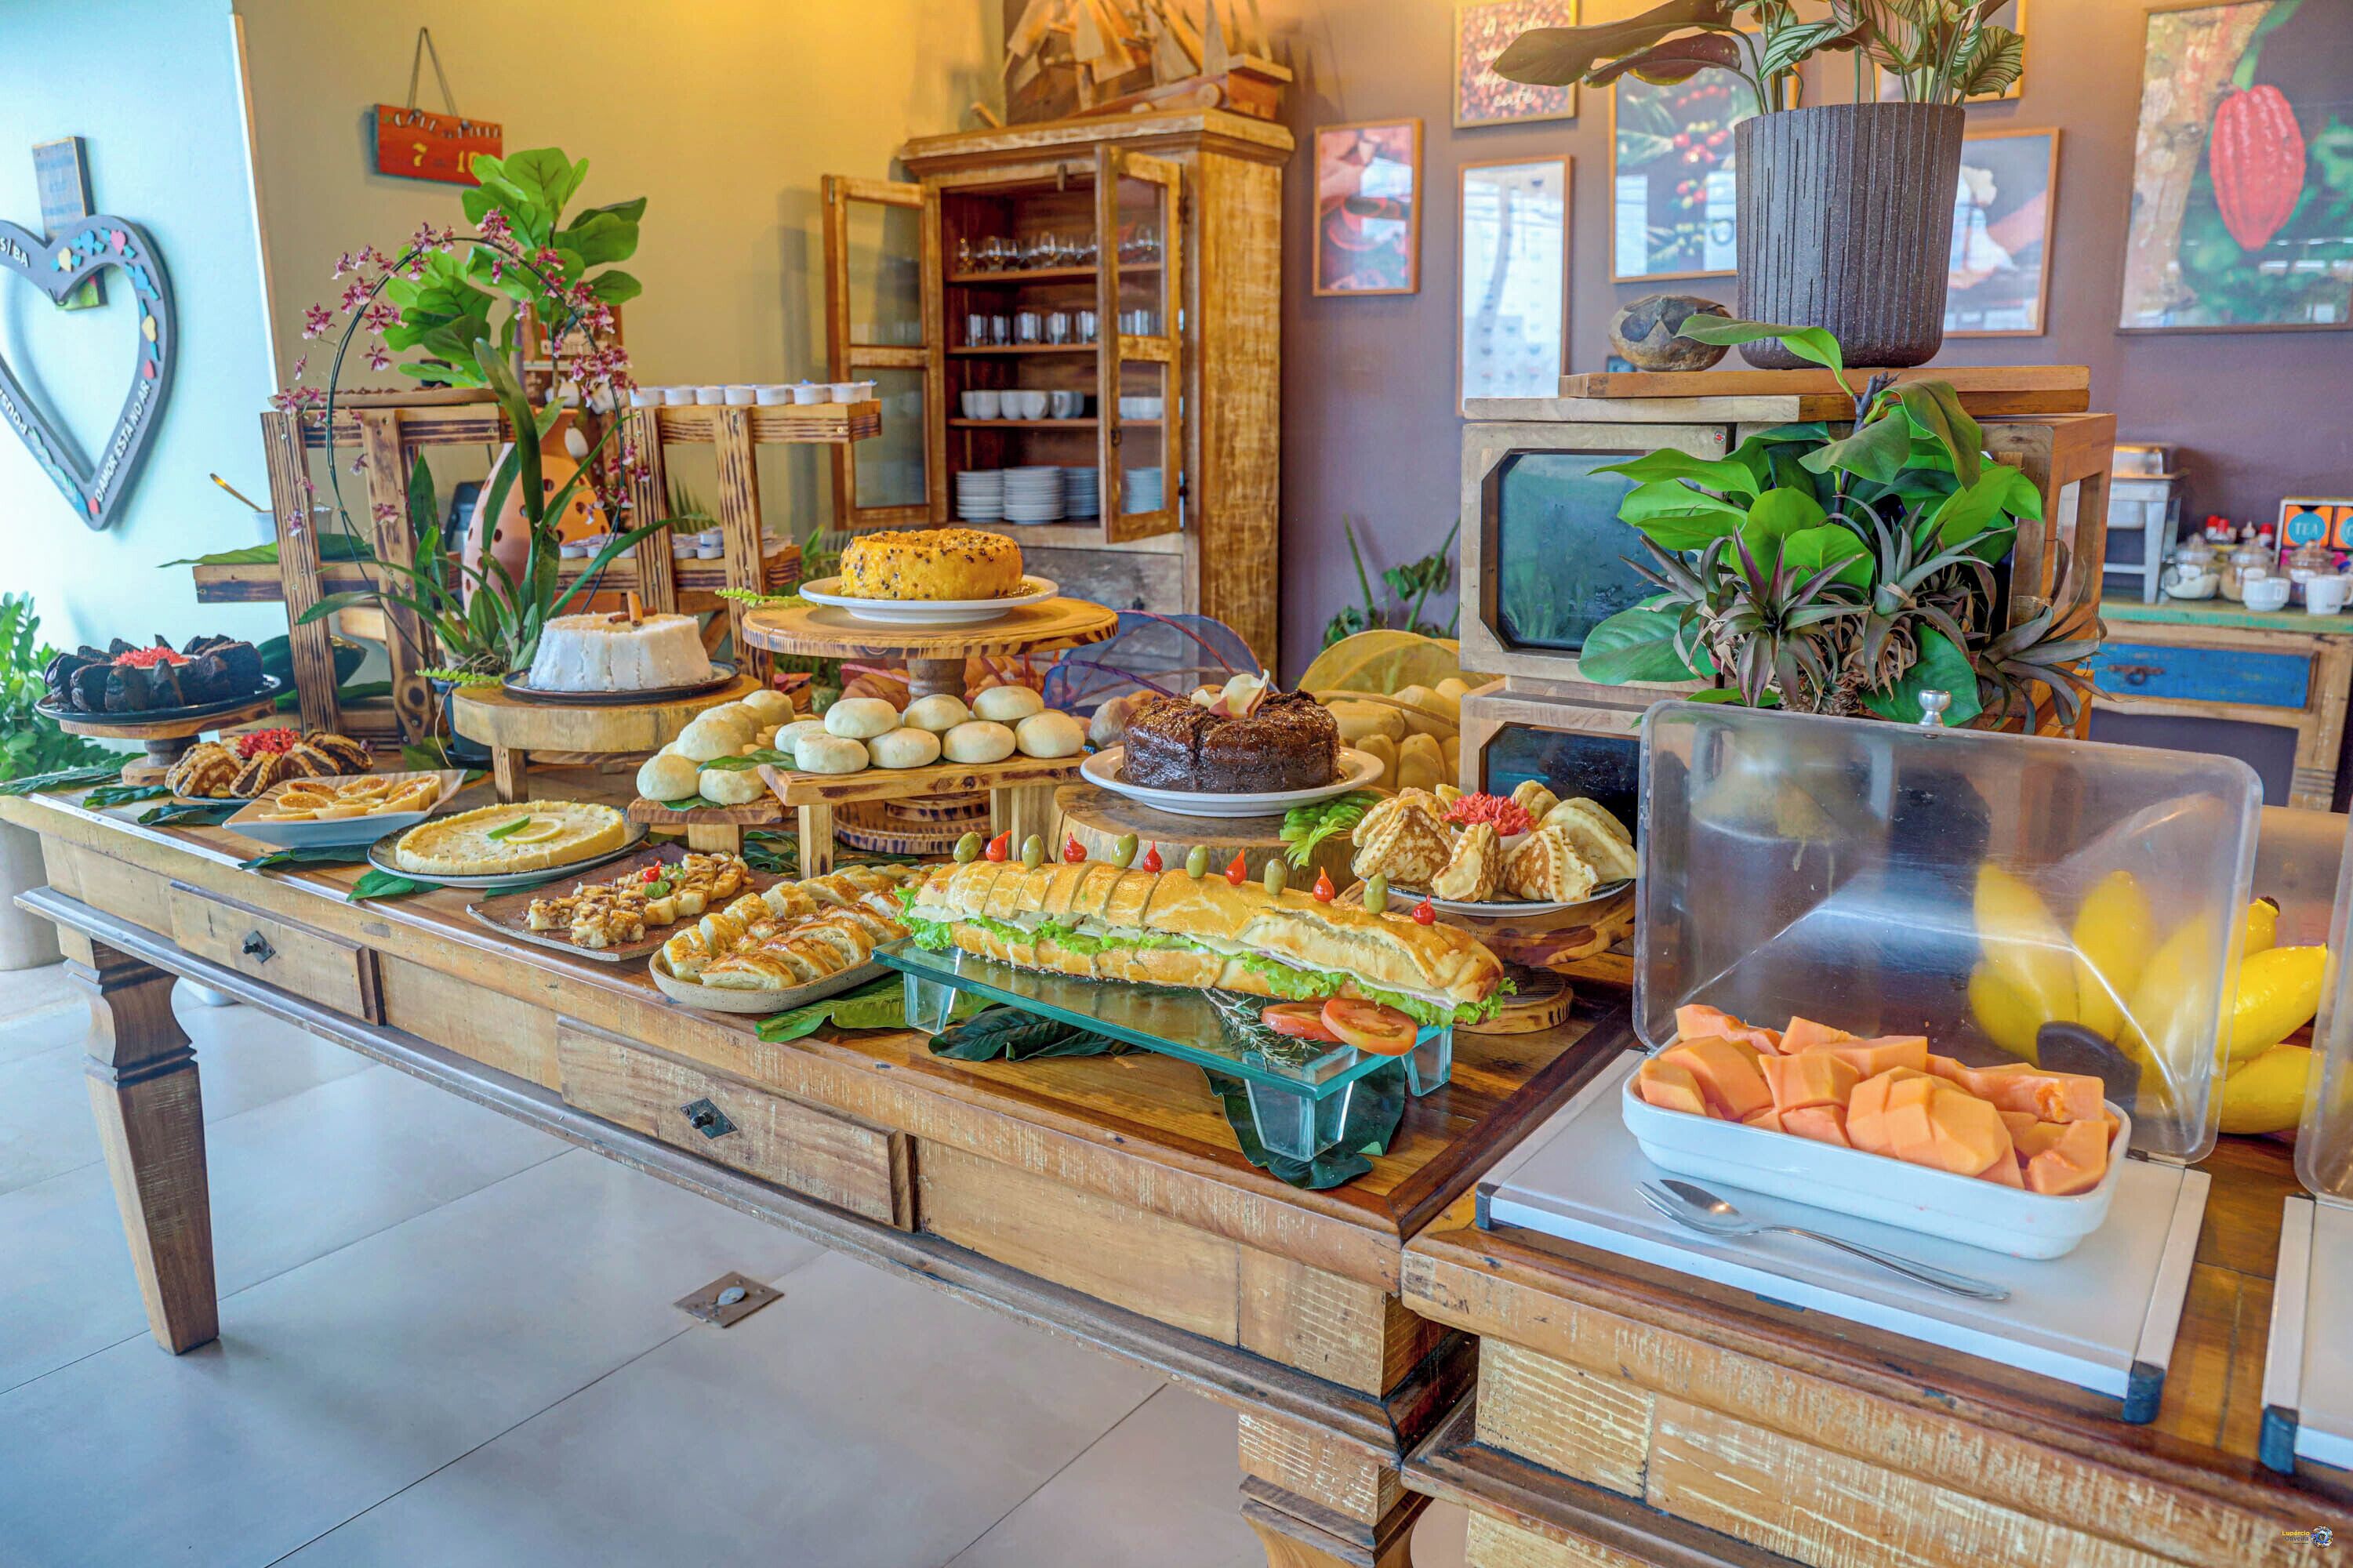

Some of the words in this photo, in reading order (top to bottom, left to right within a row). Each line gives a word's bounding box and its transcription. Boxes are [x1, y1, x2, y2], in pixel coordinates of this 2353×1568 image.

[413, 142, 427, 167] 7
[137, 379, 151, 404] AR
[129, 402, 143, 424] NO
[114, 417, 134, 458] ESTÁ
[99, 454, 118, 492] AMOR
[95, 490, 104, 503] O
[2295, 522, 2319, 535] TEA
